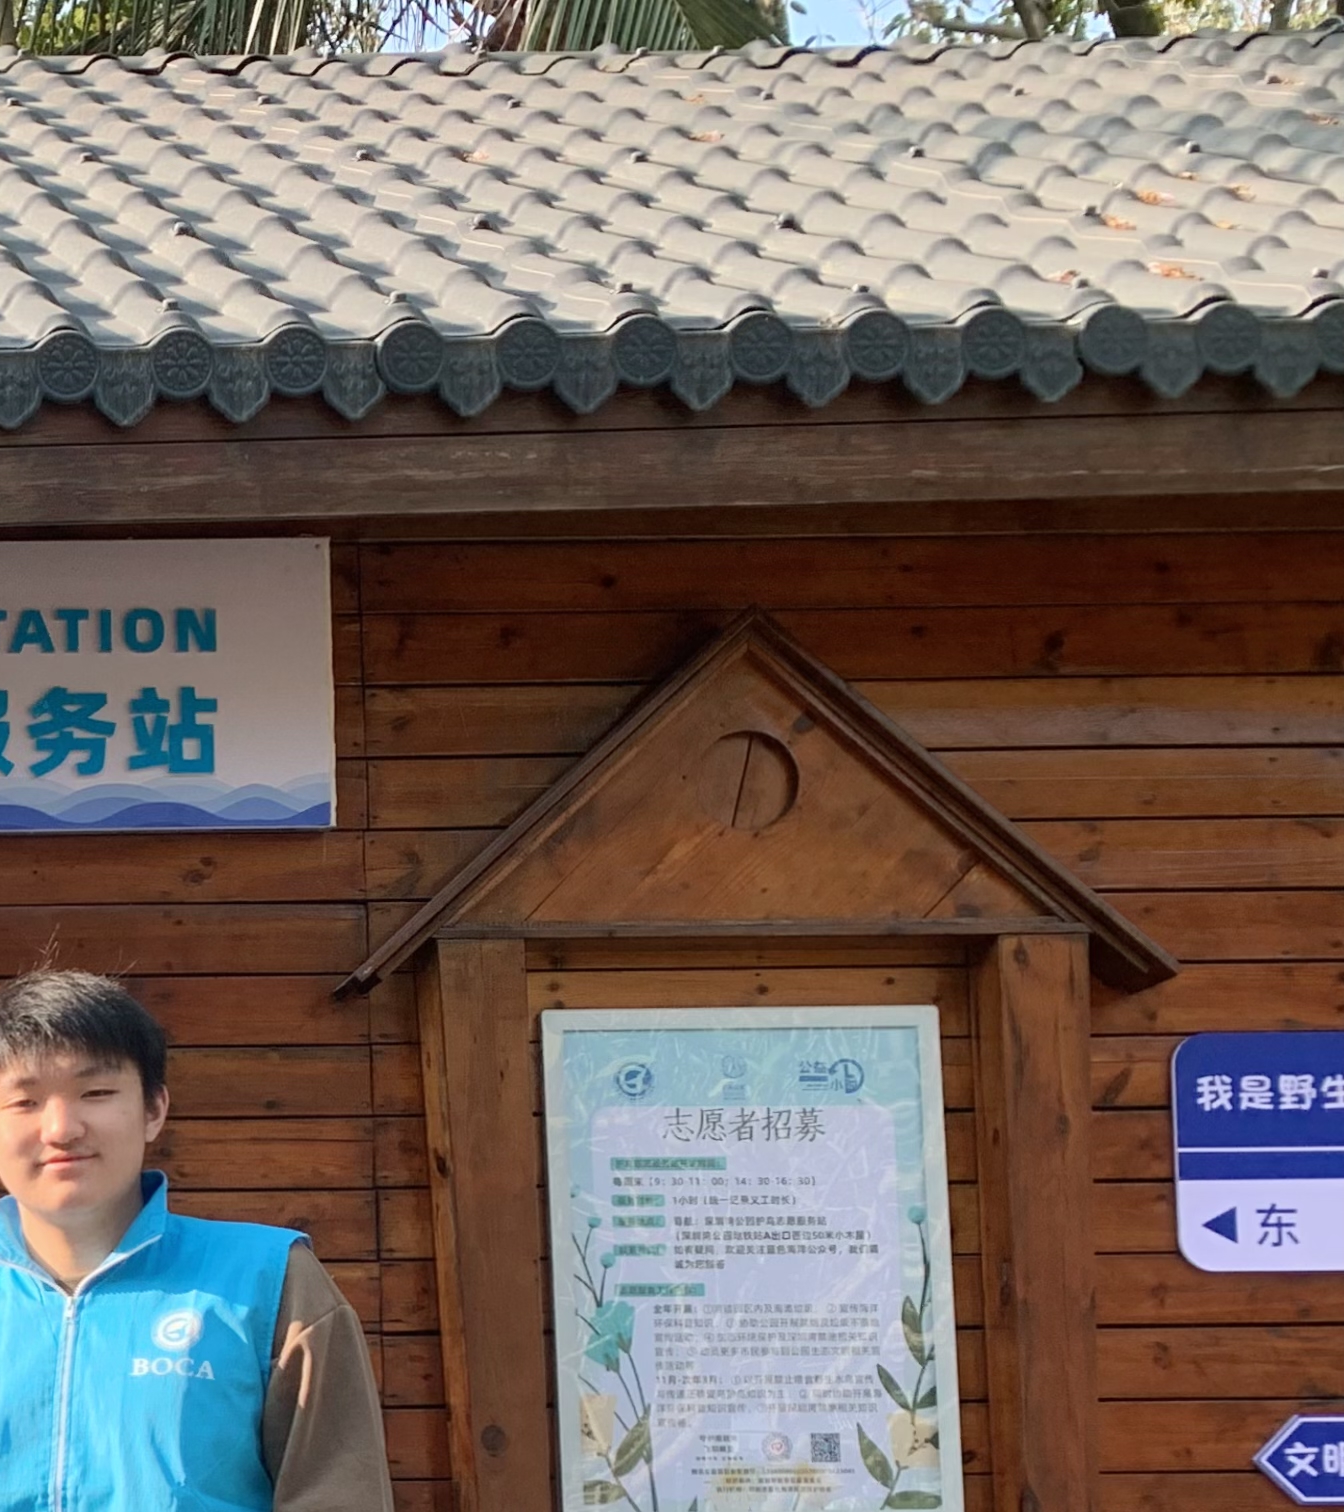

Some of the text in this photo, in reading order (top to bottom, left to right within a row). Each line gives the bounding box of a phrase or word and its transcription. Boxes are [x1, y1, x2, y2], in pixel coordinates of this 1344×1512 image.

[1196, 1074, 1344, 1111] 我是野生
[662, 1107, 826, 1142] 志愿者招募
[1256, 1203, 1300, 1247] 东
[130, 1357, 216, 1381] BOCA
